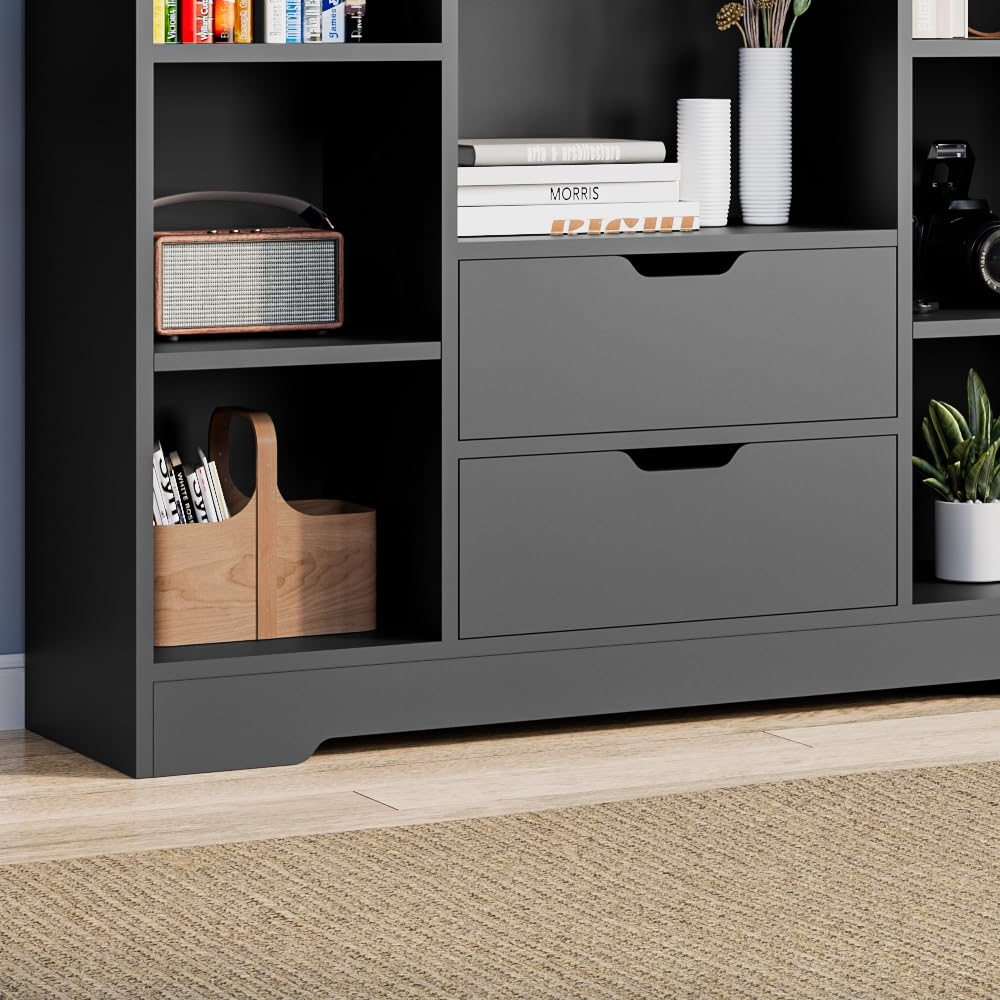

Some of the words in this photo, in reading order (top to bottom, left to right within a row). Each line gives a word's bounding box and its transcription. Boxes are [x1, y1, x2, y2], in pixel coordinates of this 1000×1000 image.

[200, 16, 209, 41] William
[328, 8, 339, 39] James
[549, 185, 600, 201] MORRIS
[177, 471, 190, 502] WHITE
